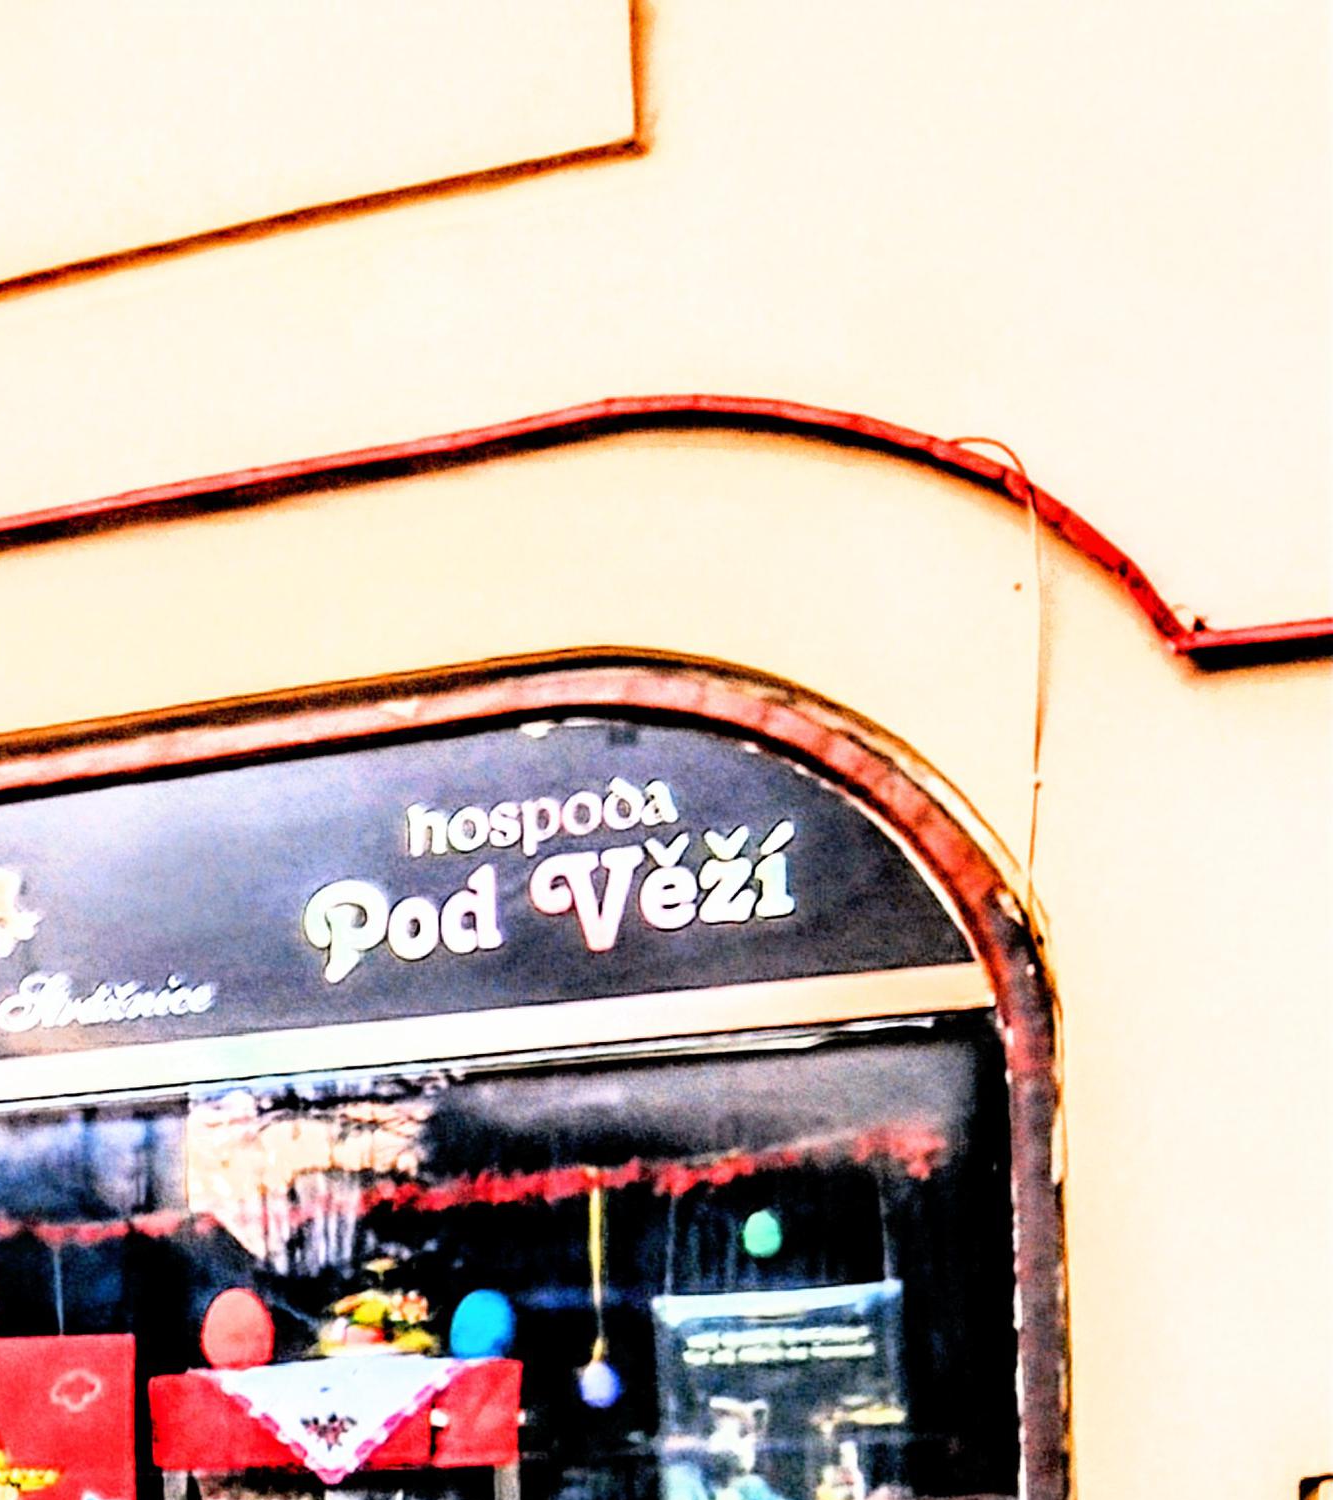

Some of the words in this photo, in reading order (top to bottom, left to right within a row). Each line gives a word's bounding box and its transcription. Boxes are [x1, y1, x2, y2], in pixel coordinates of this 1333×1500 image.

[405, 777, 678, 857] hospoda
[301, 862, 505, 985] Pod
[529, 820, 796, 952] Věží
